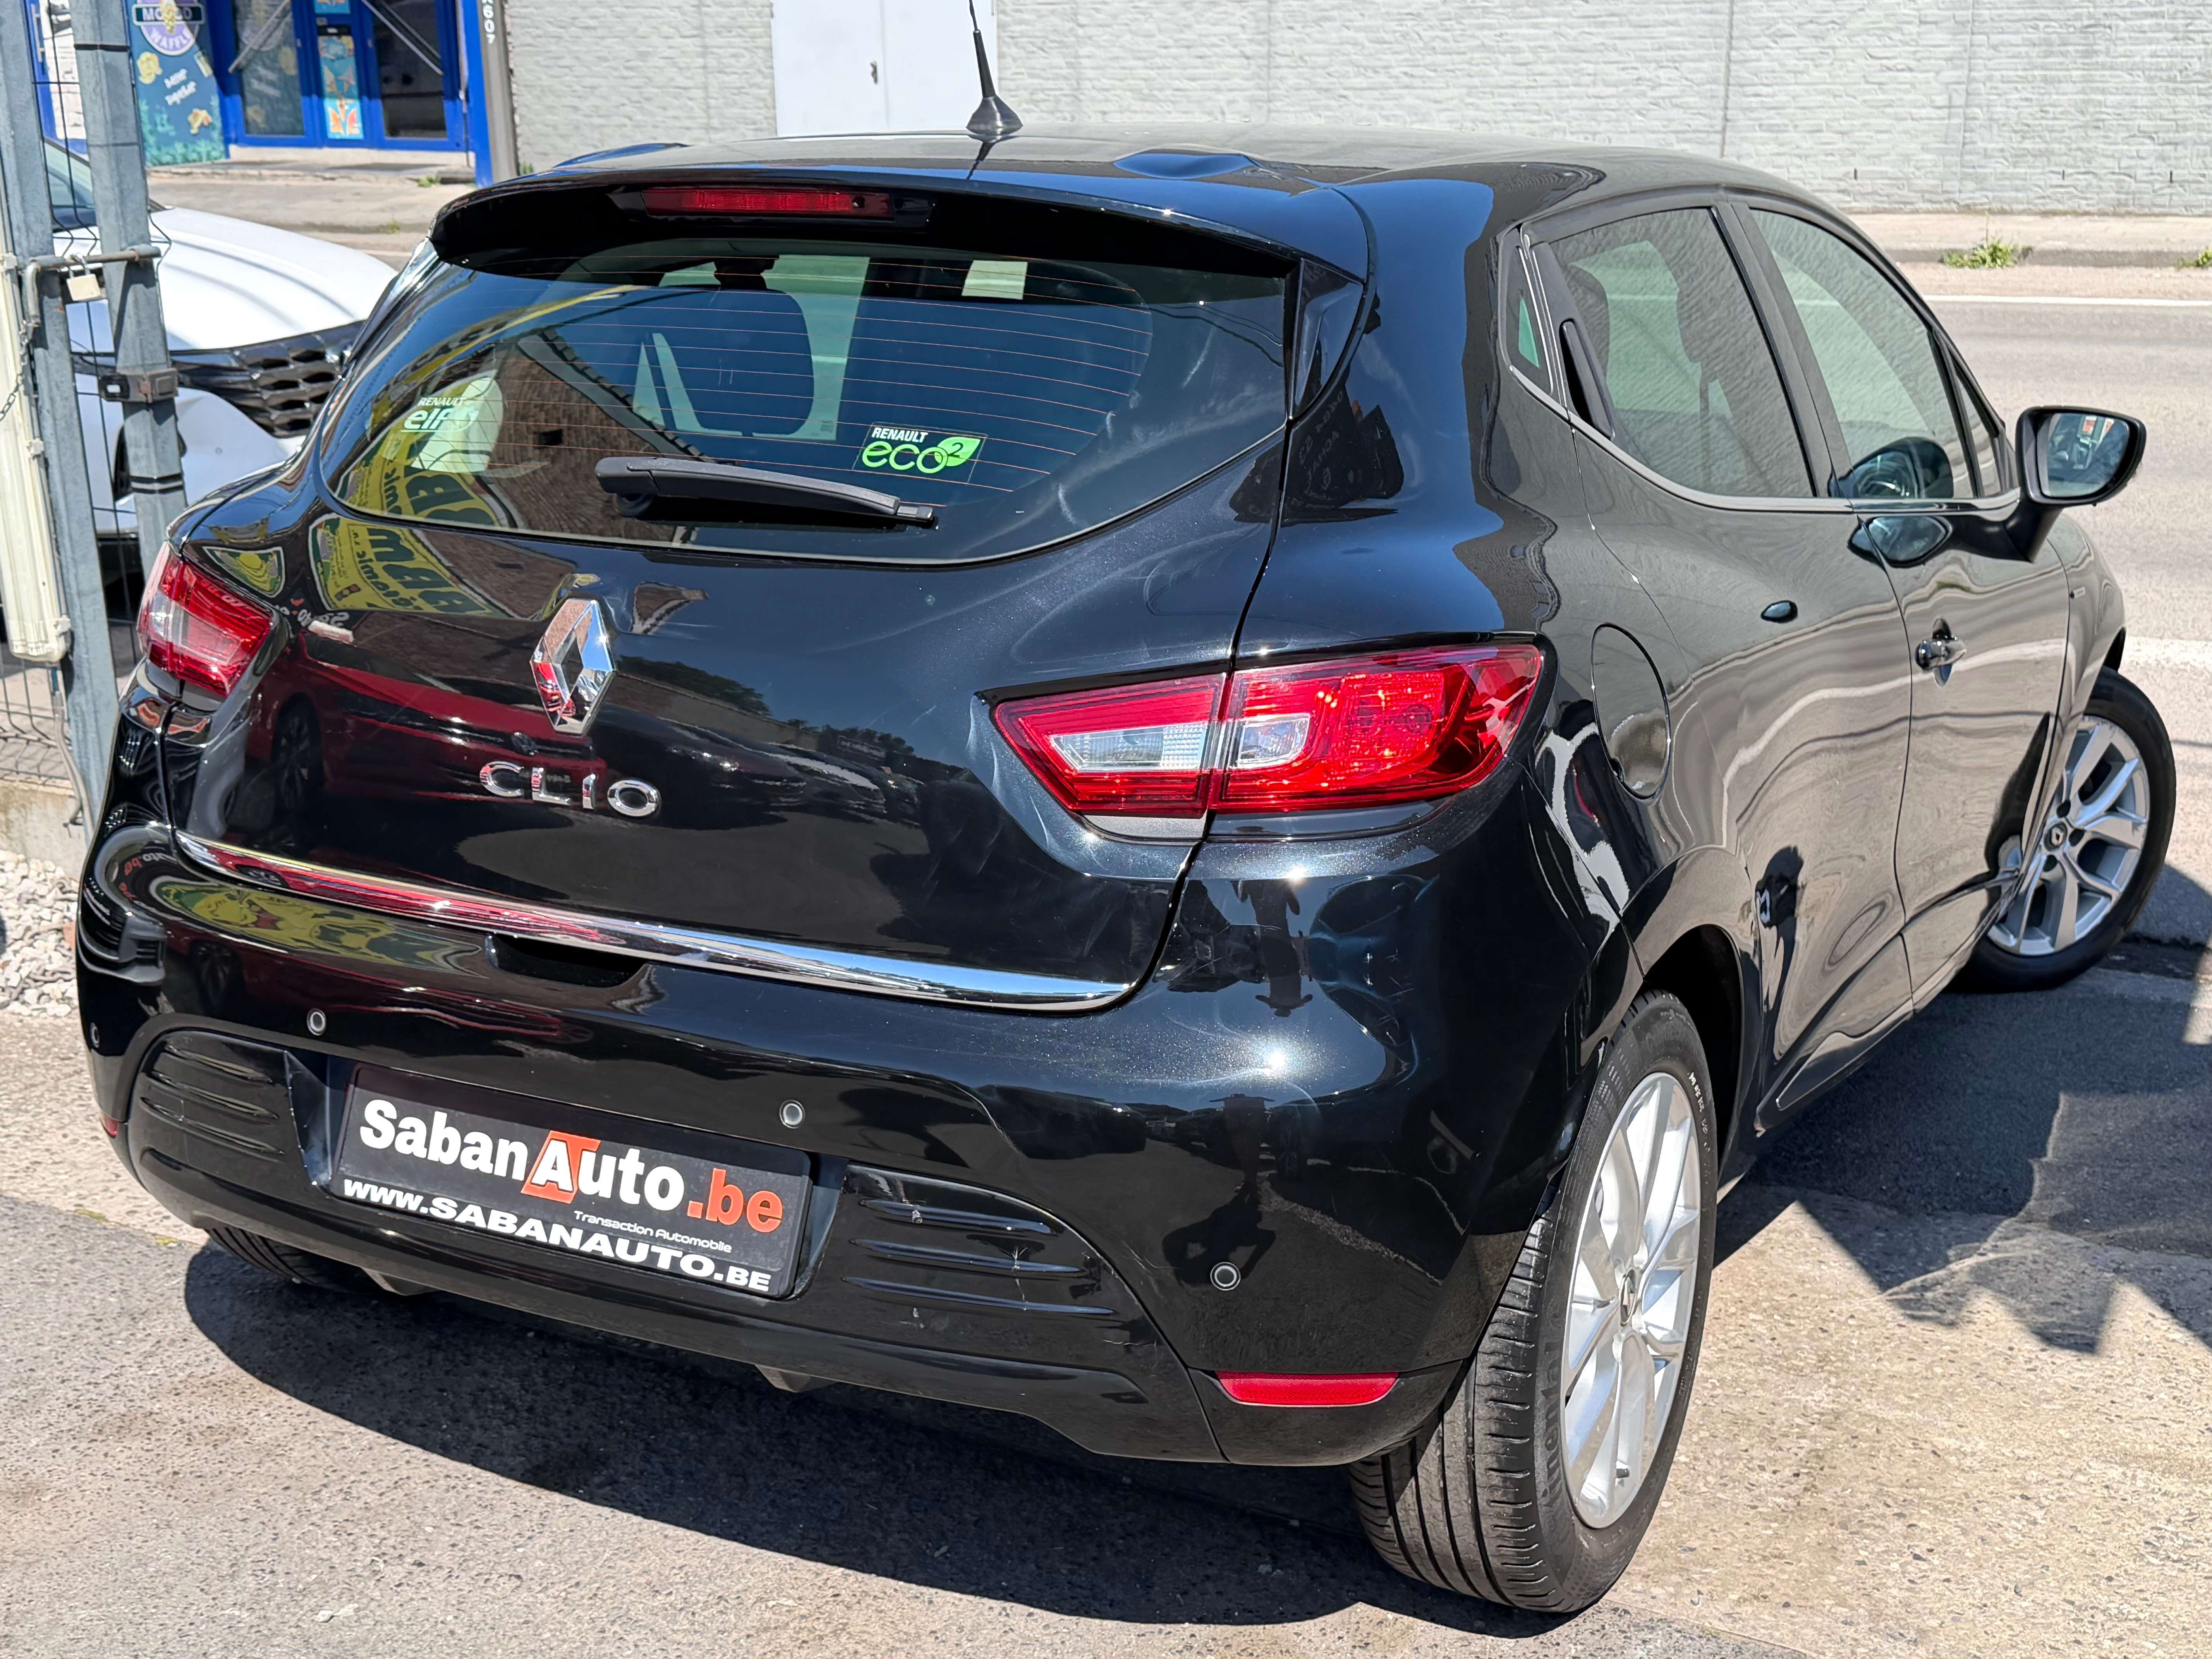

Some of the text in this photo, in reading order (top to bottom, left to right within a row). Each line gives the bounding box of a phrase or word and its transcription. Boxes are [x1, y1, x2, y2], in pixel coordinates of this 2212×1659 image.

[417, 397, 467, 406] RENAULT
[404, 405, 459, 430] elf
[871, 427, 928, 443] RENAULT
[479, 761, 661, 817] CLIO
[574, 1211, 732, 1253] Transaction Automobile
